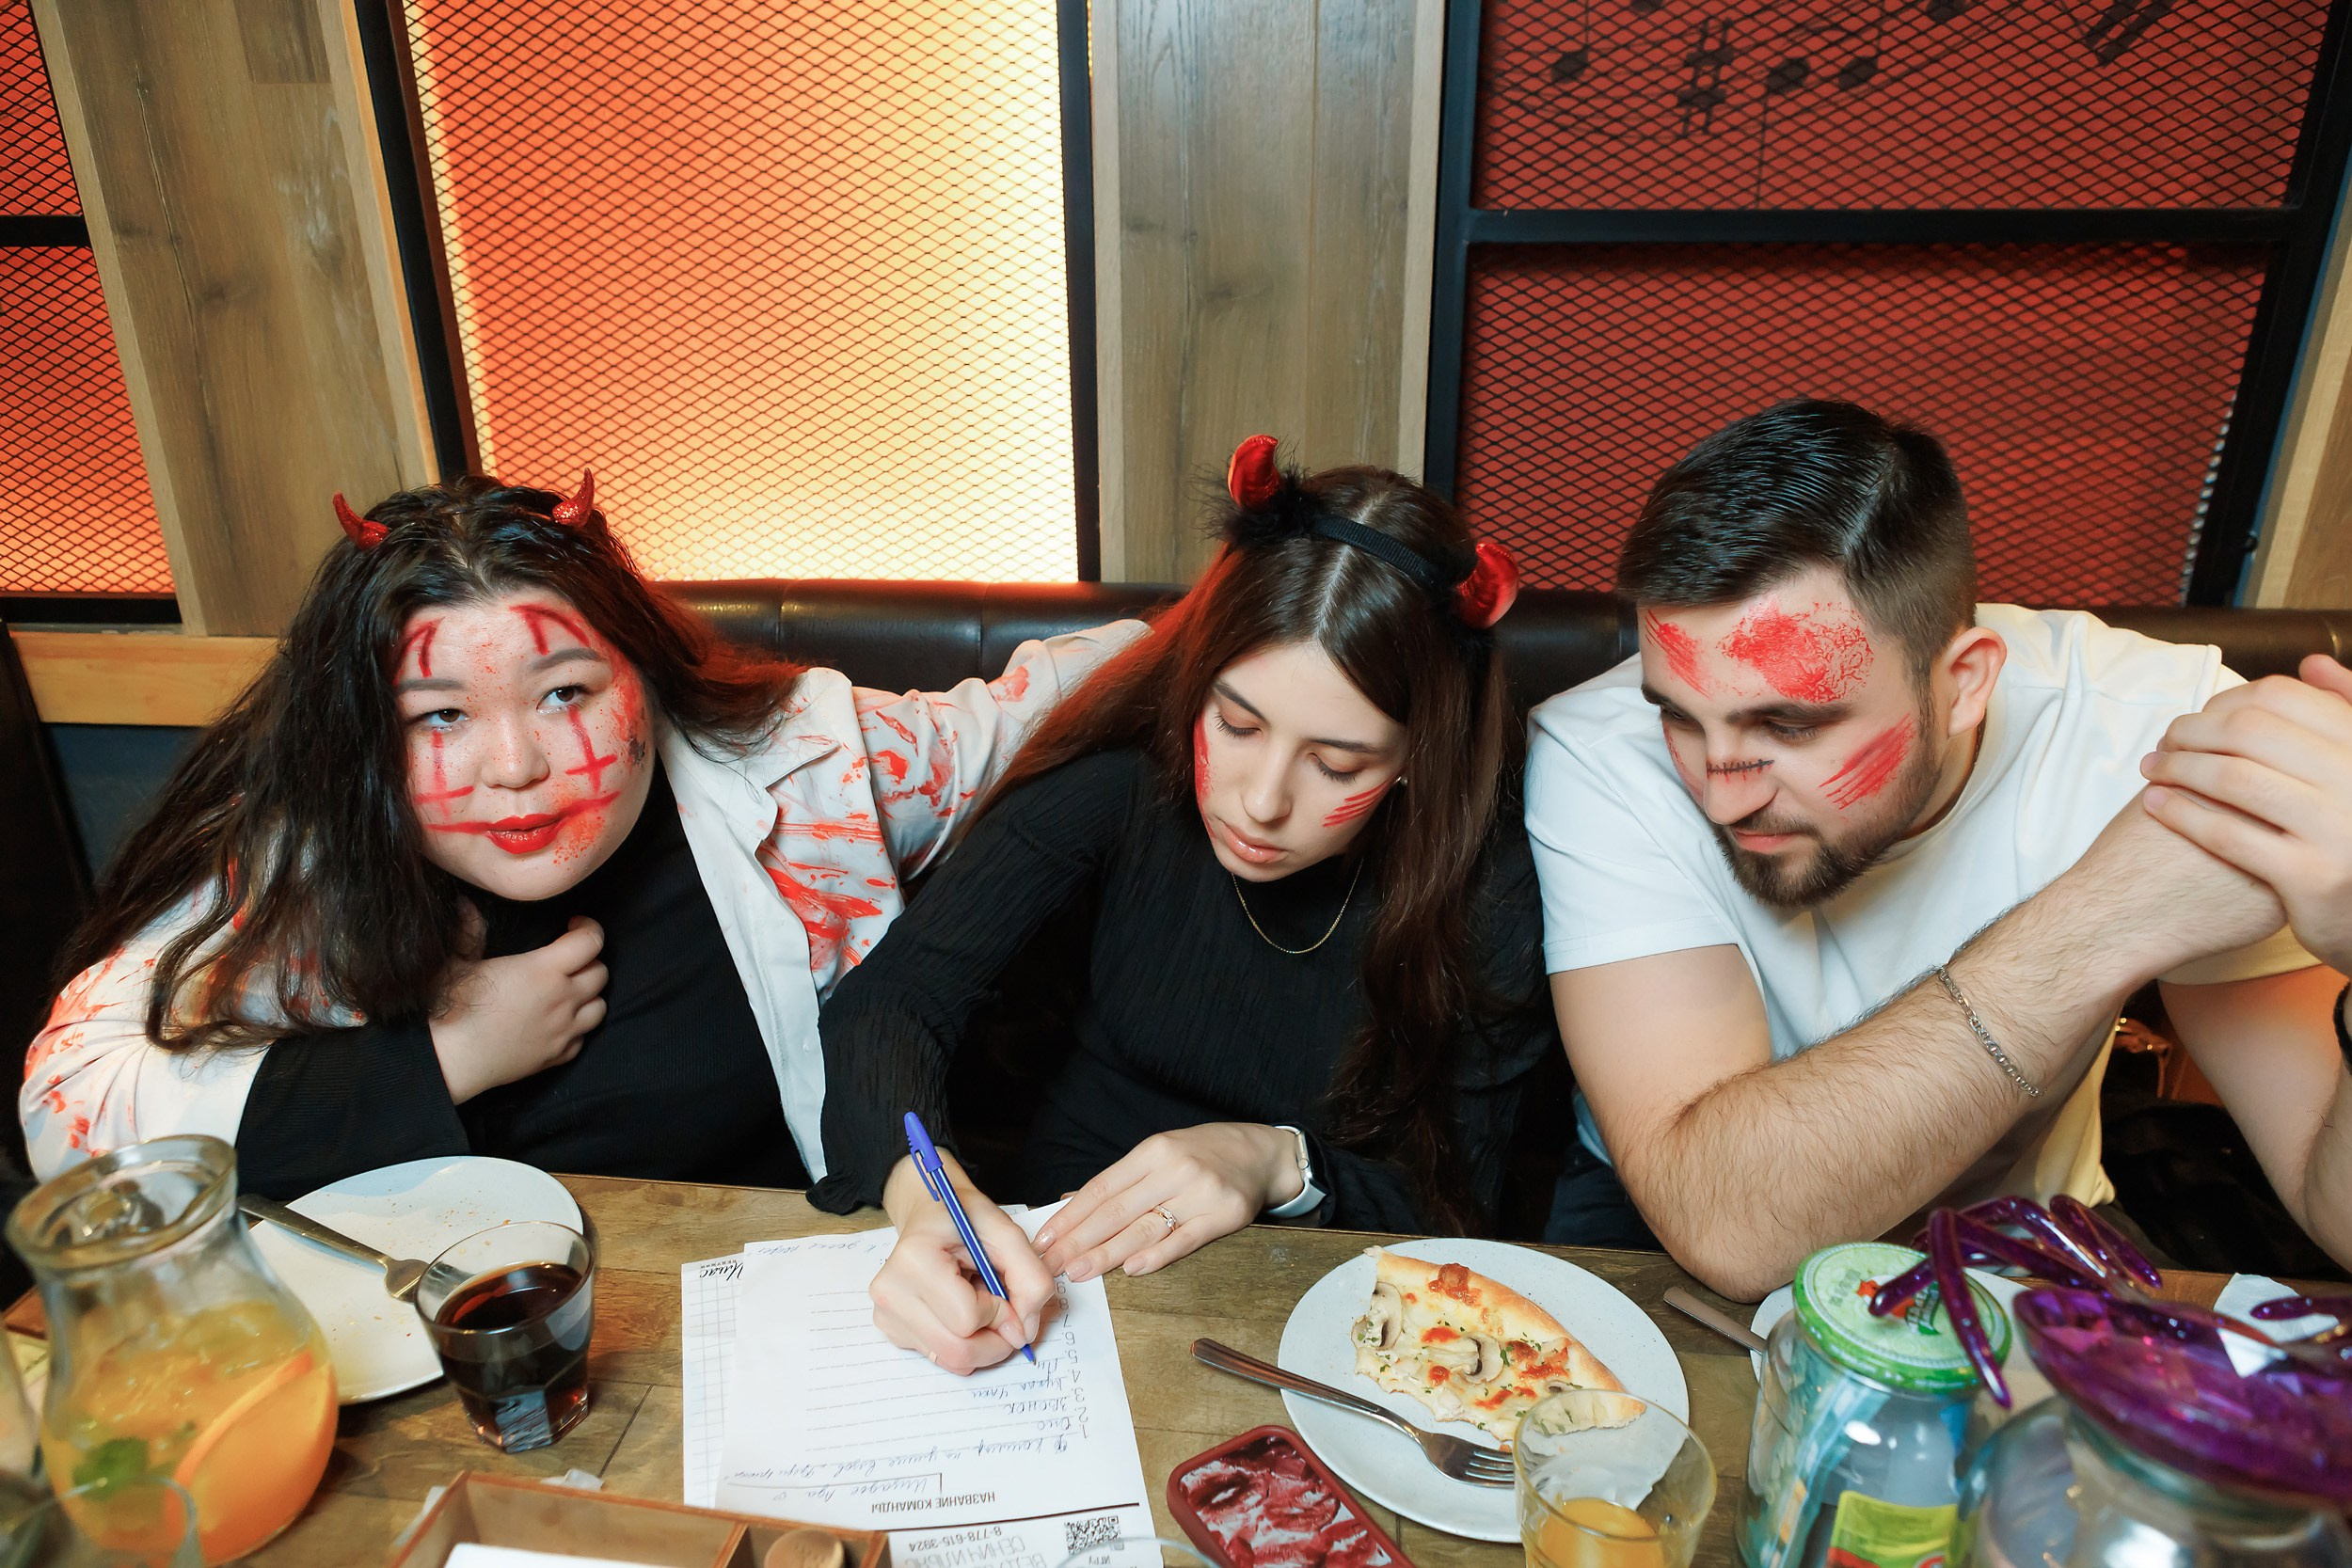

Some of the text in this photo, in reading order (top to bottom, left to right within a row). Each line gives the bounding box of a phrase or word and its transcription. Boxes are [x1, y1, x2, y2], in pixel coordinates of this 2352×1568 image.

[1058, 1313, 1072, 1328] 7.
[1061, 1331, 1075, 1345] 6.
[1064, 1349, 1078, 1364] 5.
[1067, 1368, 1081, 1383] 4.
[1071, 1387, 1085, 1403] 3.
[1073, 1406, 1089, 1423] 2.
[1079, 1425, 1089, 1439] 1.
[871, 1491, 995, 1513] НАЗВАНИЕ КОМАНДЫ
